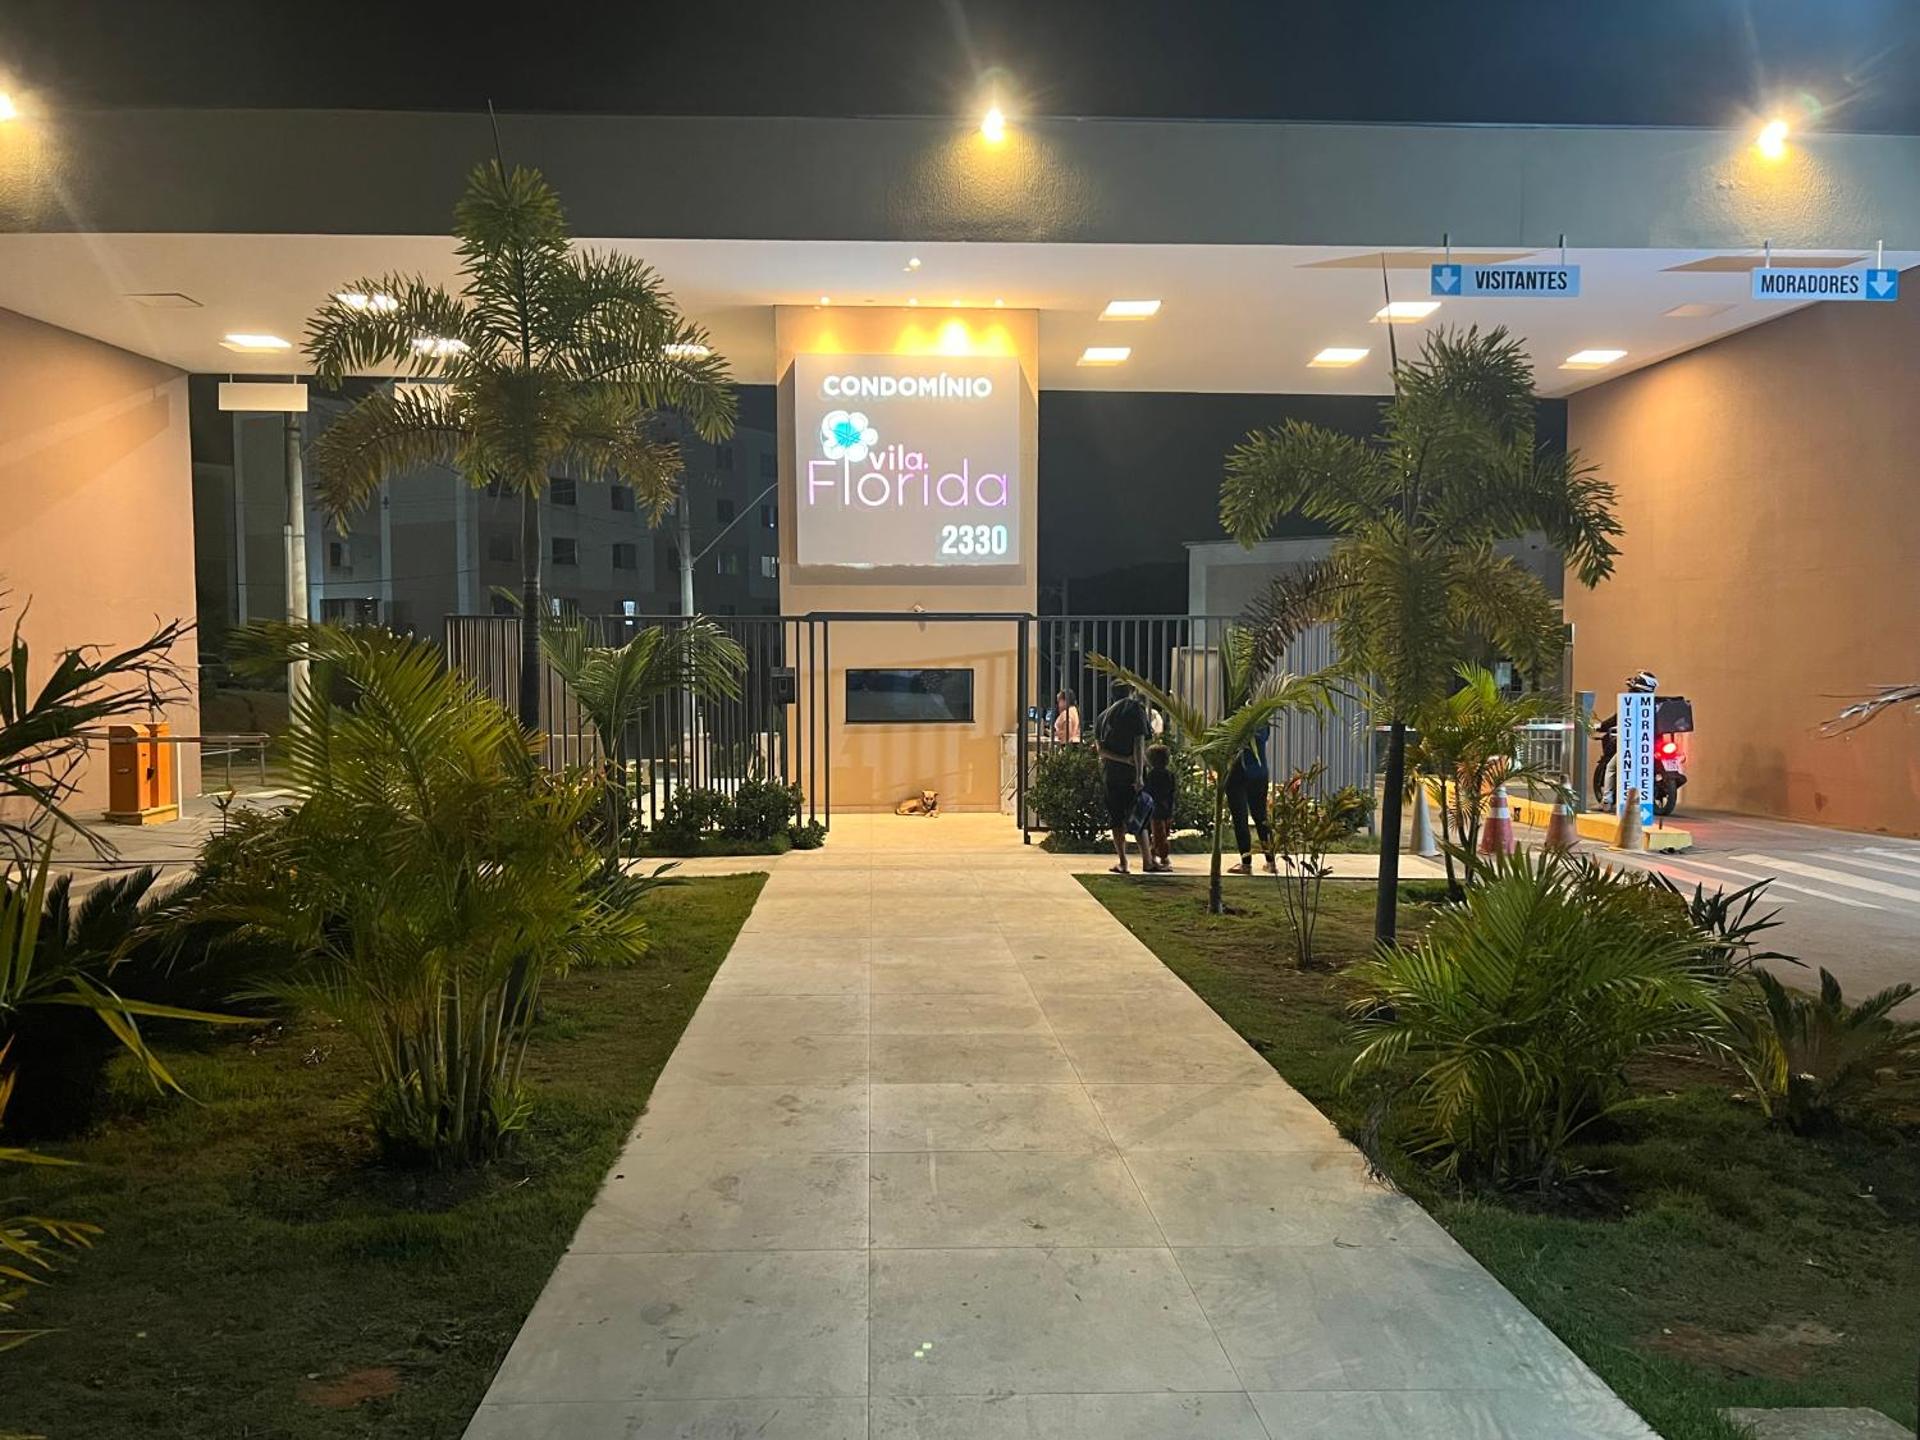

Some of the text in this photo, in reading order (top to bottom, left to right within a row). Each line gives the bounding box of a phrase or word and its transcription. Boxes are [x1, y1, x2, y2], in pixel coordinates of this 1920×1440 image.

[1475, 270, 1568, 290] VISITANTES
[1761, 275, 1859, 294] MORADORES
[823, 372, 993, 397] CONDOMÍNIO
[808, 458, 1008, 507] Florida
[941, 525, 1008, 555] 2330
[1640, 697, 1650, 801] MORADORES
